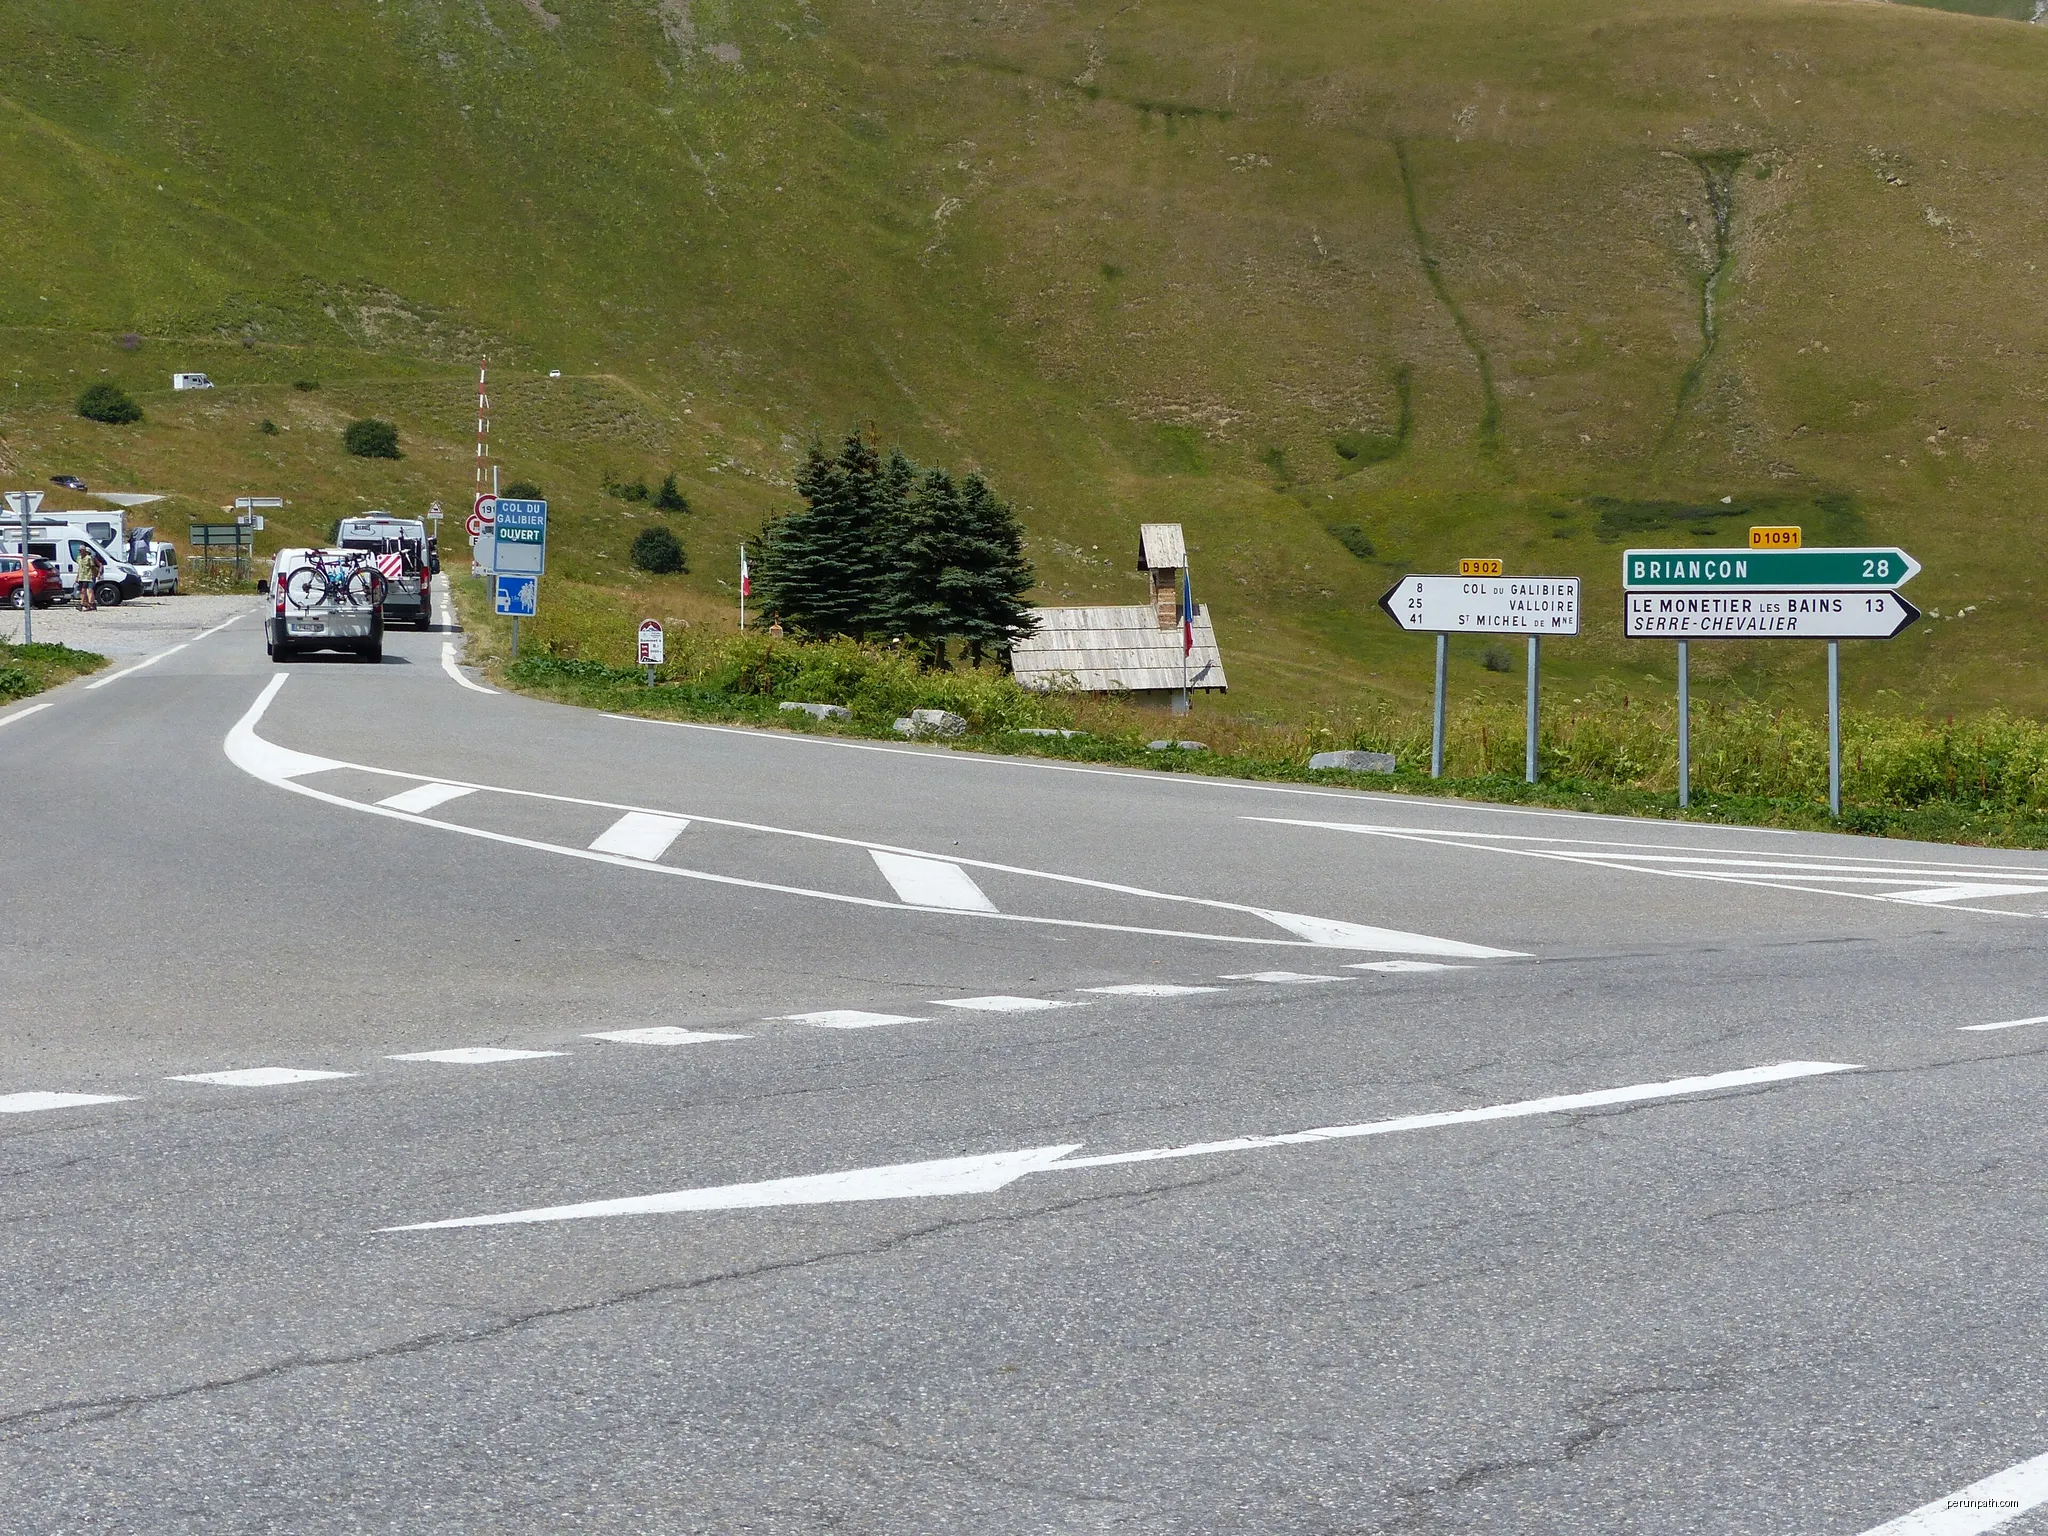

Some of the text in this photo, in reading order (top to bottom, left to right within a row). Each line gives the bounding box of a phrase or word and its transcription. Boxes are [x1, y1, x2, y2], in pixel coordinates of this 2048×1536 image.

[502, 503, 540, 514] COL DU
[497, 514, 544, 525] GALIBIER
[500, 528, 540, 540] OUVERT
[1634, 559, 1889, 580] BRIANÇON 28
[1416, 582, 1574, 596] 8 COL DU GALIBIER
[1408, 598, 1574, 612] 25 VALLOIRE
[1633, 598, 1885, 613] LE MONETIER LES BAINS 13
[1410, 614, 1423, 624] 41
[1476, 615, 1527, 627] MICHEL
[1534, 619, 1545, 627] DE
[1634, 617, 1798, 631] SERRE-CHEVALIER
